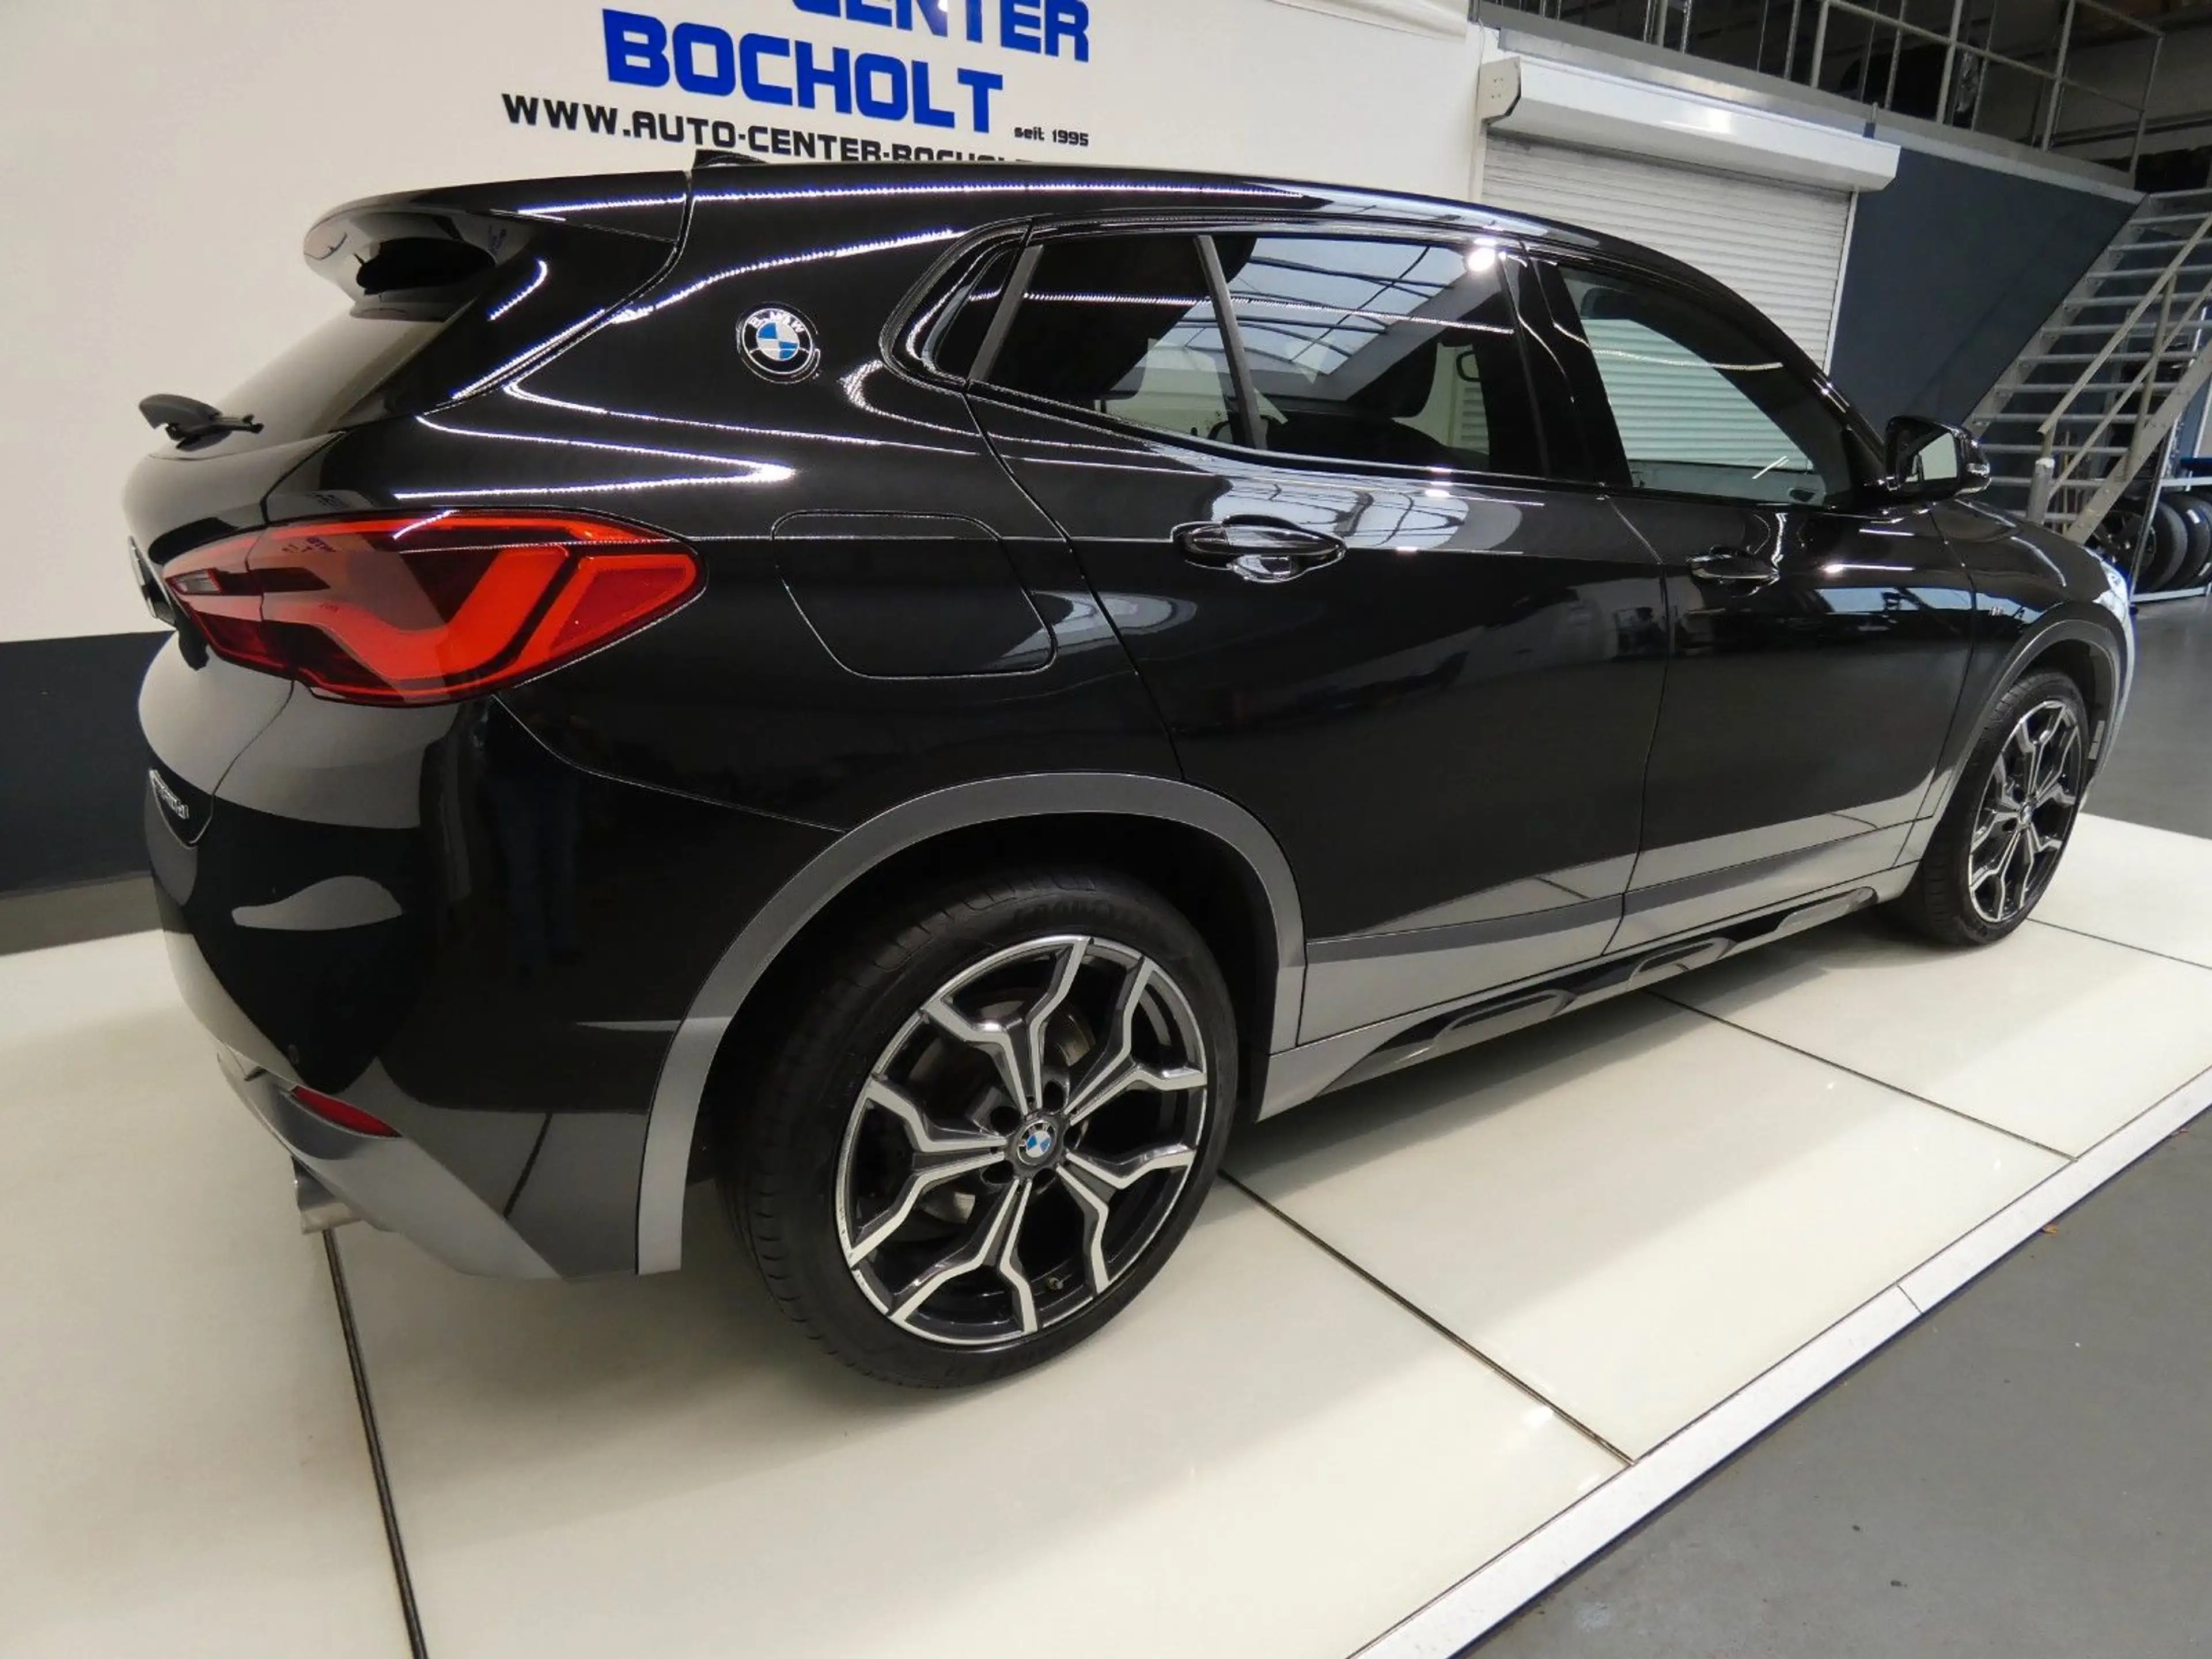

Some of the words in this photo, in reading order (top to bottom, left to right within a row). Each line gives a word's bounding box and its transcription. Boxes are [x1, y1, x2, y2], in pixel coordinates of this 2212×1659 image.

[603, 8, 1003, 133] BOCHOLT
[1014, 126, 1044, 141] seit
[1052, 129, 1089, 146] 1995
[748, 310, 805, 333] BMW
